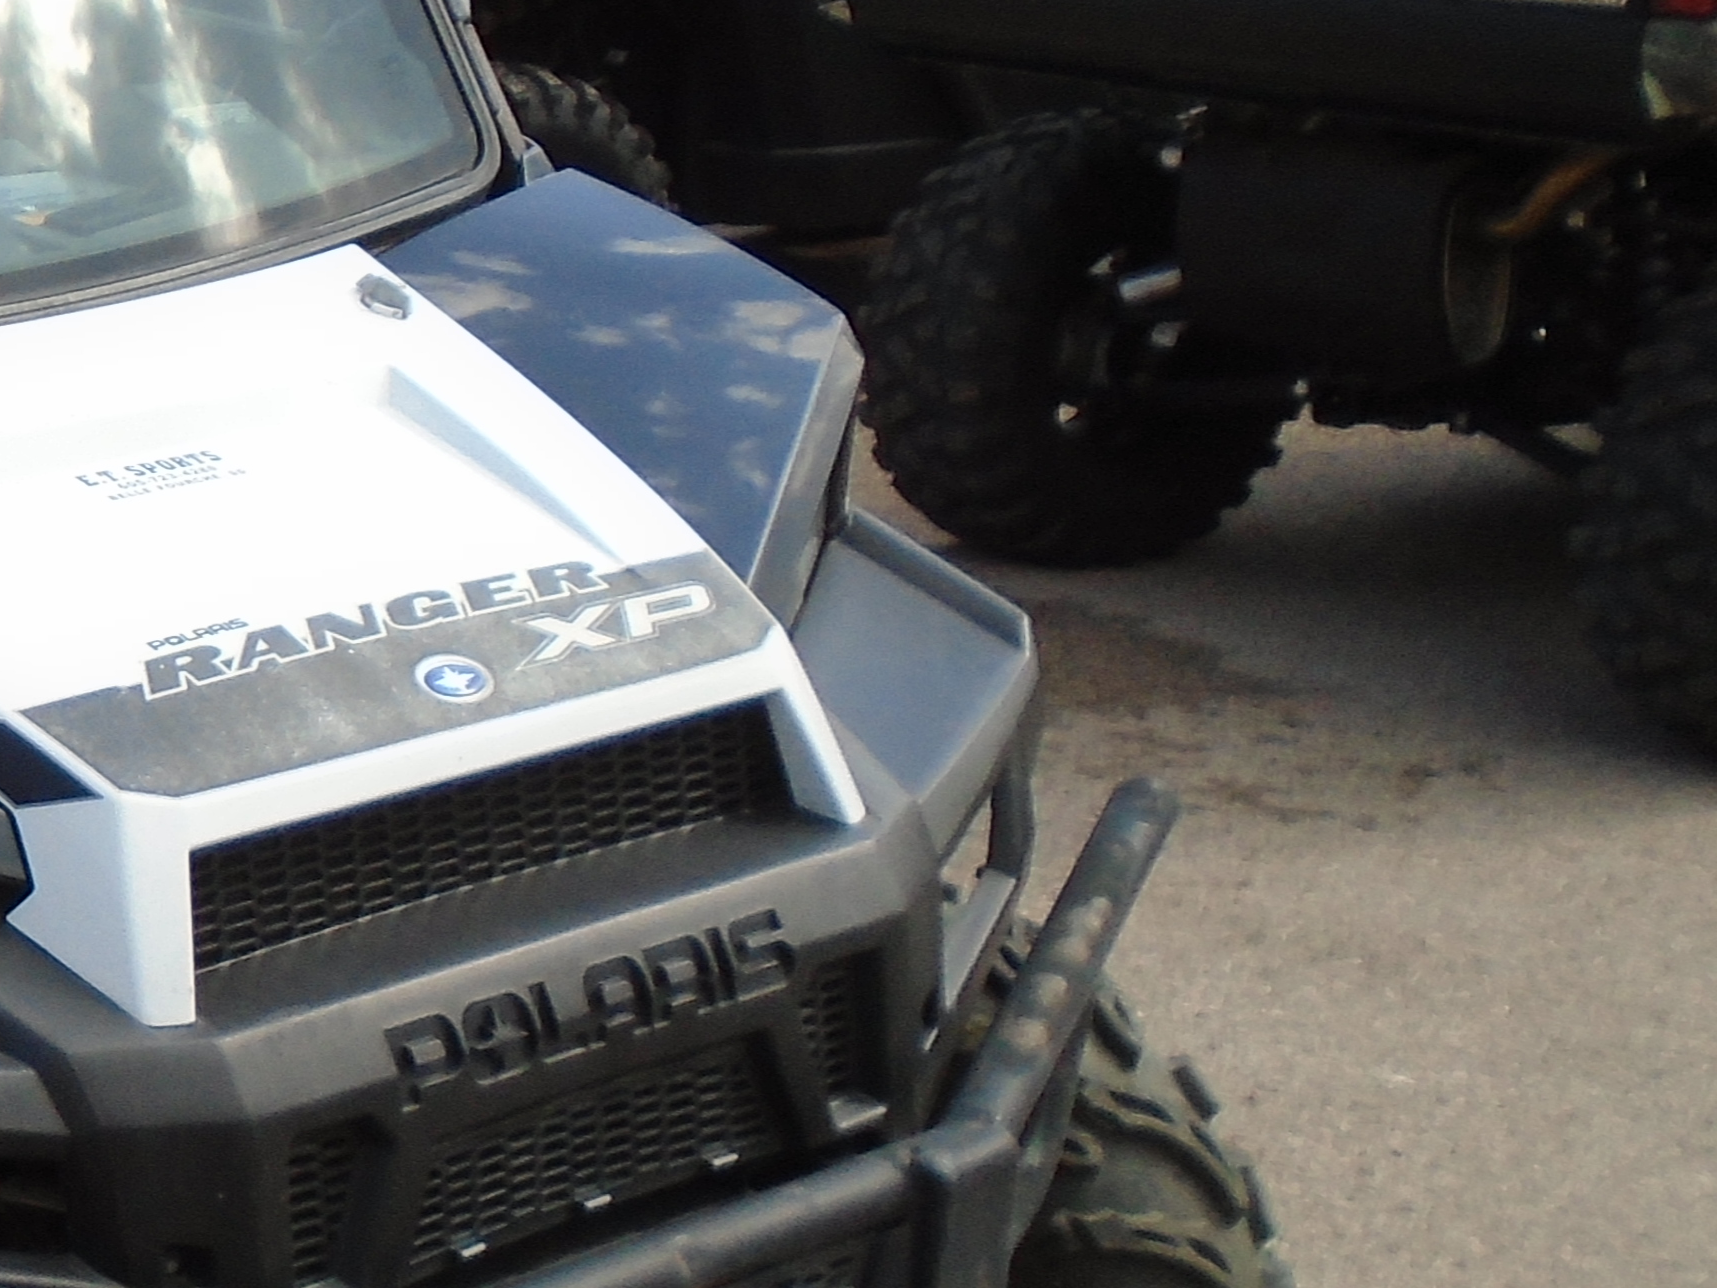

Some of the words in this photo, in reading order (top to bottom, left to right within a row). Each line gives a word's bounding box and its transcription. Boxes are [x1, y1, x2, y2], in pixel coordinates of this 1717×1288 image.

[75, 470, 127, 486] E.T.
[123, 450, 222, 477] SPORTS
[142, 560, 611, 700] RANGER
[148, 617, 249, 650] POLARIS
[514, 580, 716, 670] XP
[383, 909, 796, 1112] POLARIS
